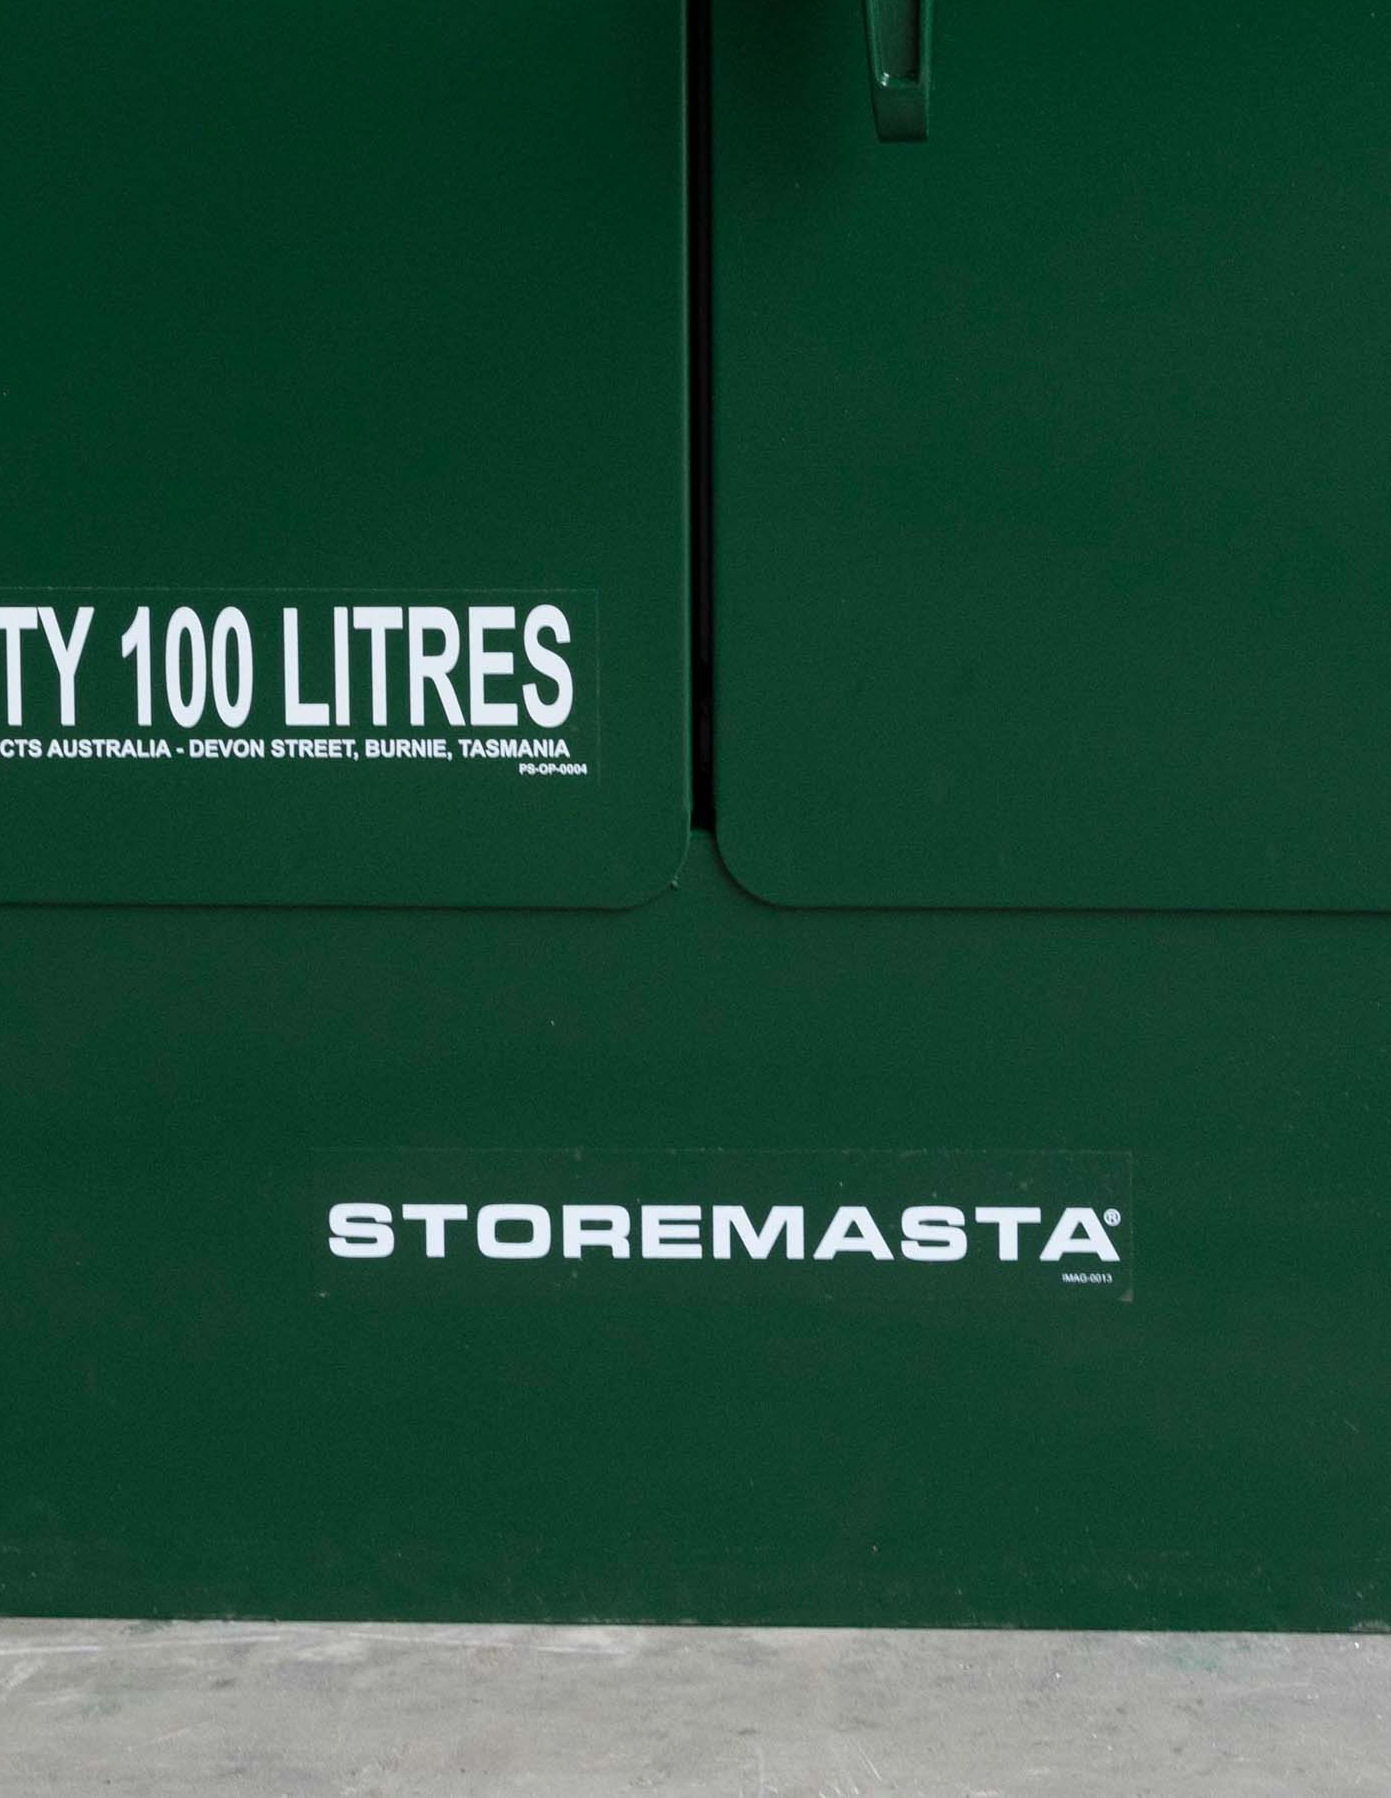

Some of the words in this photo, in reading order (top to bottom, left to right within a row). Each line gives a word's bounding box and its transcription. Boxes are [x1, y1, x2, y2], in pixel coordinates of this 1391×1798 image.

[122, 606, 253, 727] 100
[284, 605, 573, 727] LITRES
[46, 738, 172, 758] AUSTRALIA
[189, 738, 265, 758] DEVON
[270, 738, 359, 761] STREET,
[365, 738, 453, 761] BURNIE,
[457, 738, 571, 758] TASMANIA
[518, 763, 588, 775] PS-OP-0004
